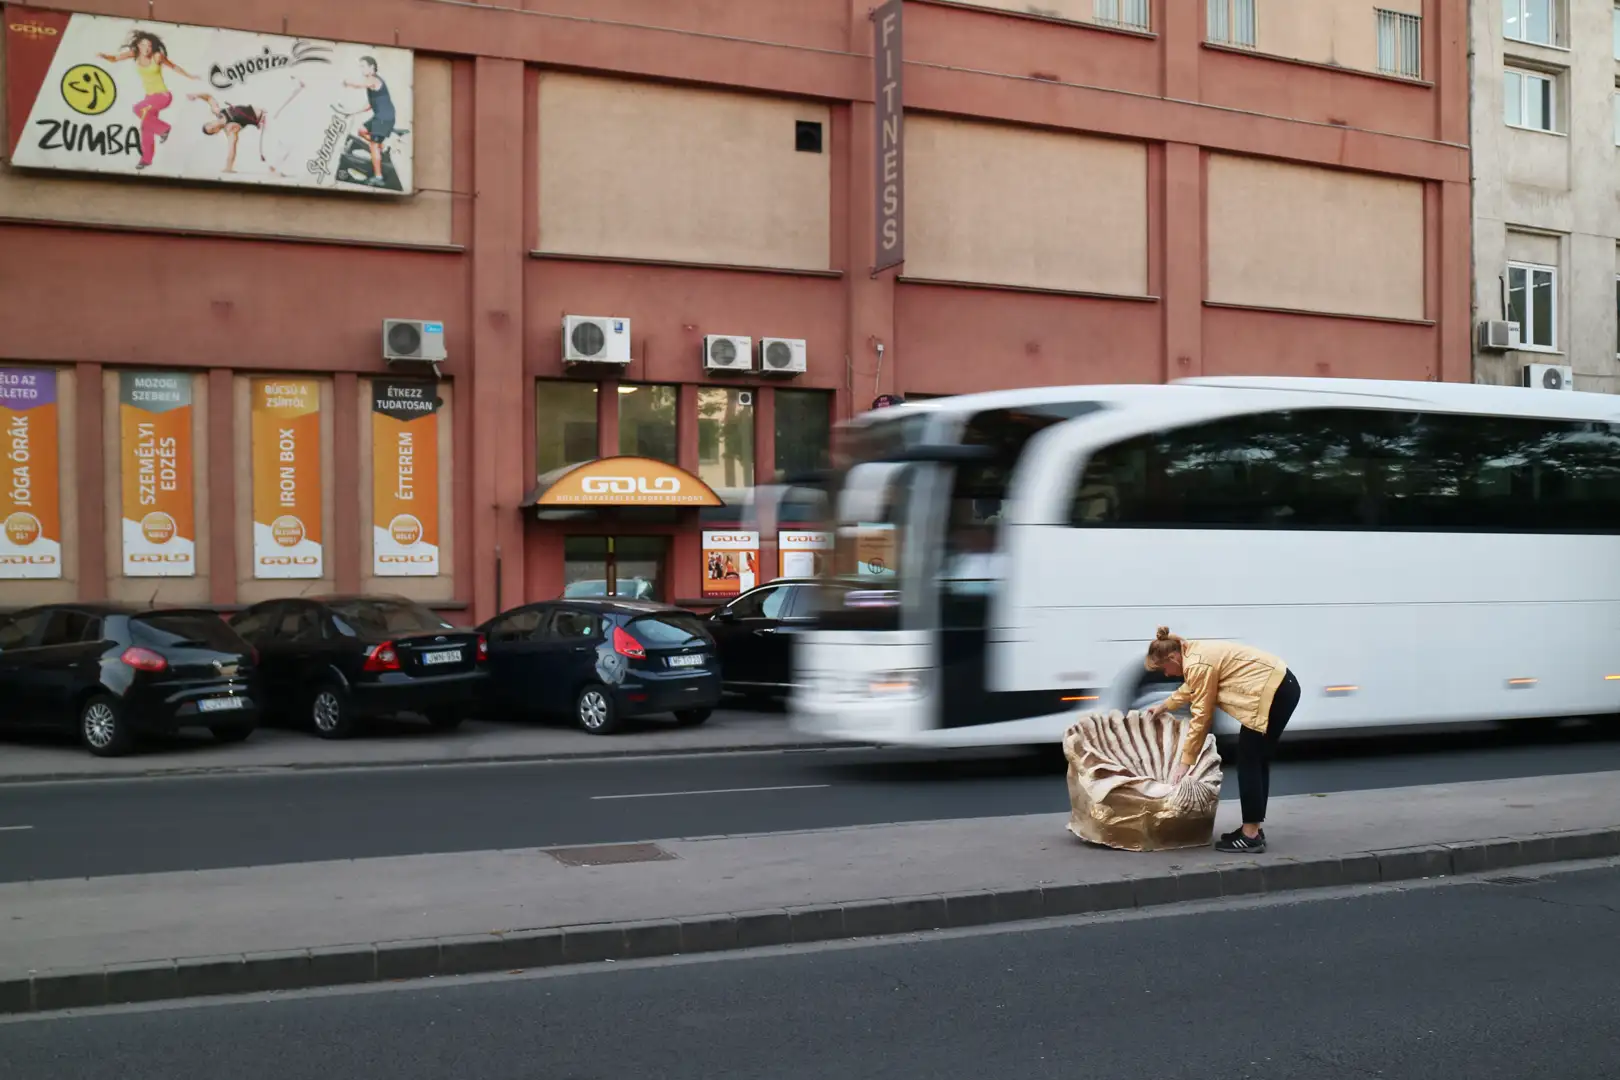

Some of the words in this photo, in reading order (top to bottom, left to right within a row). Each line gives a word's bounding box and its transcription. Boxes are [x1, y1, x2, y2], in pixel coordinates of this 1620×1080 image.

[208, 45, 289, 91] Capoeira
[36, 118, 144, 157] ZUMBA
[306, 114, 347, 184] Spinning
[881, 13, 899, 250] FITNESS
[21, 375, 37, 386] AZ
[387, 385, 423, 398] ÉTKEZZ
[377, 400, 433, 411] TUDATOSAN
[7, 416, 30, 462] ÓRÁK
[279, 428, 295, 462] BOX
[134, 423, 156, 506] SZEMÉLYI
[156, 437, 177, 491] EDZÉS
[394, 432, 414, 500] ÉTTEREM
[9, 466, 32, 506] JÓGA
[279, 466, 296, 507] IRON
